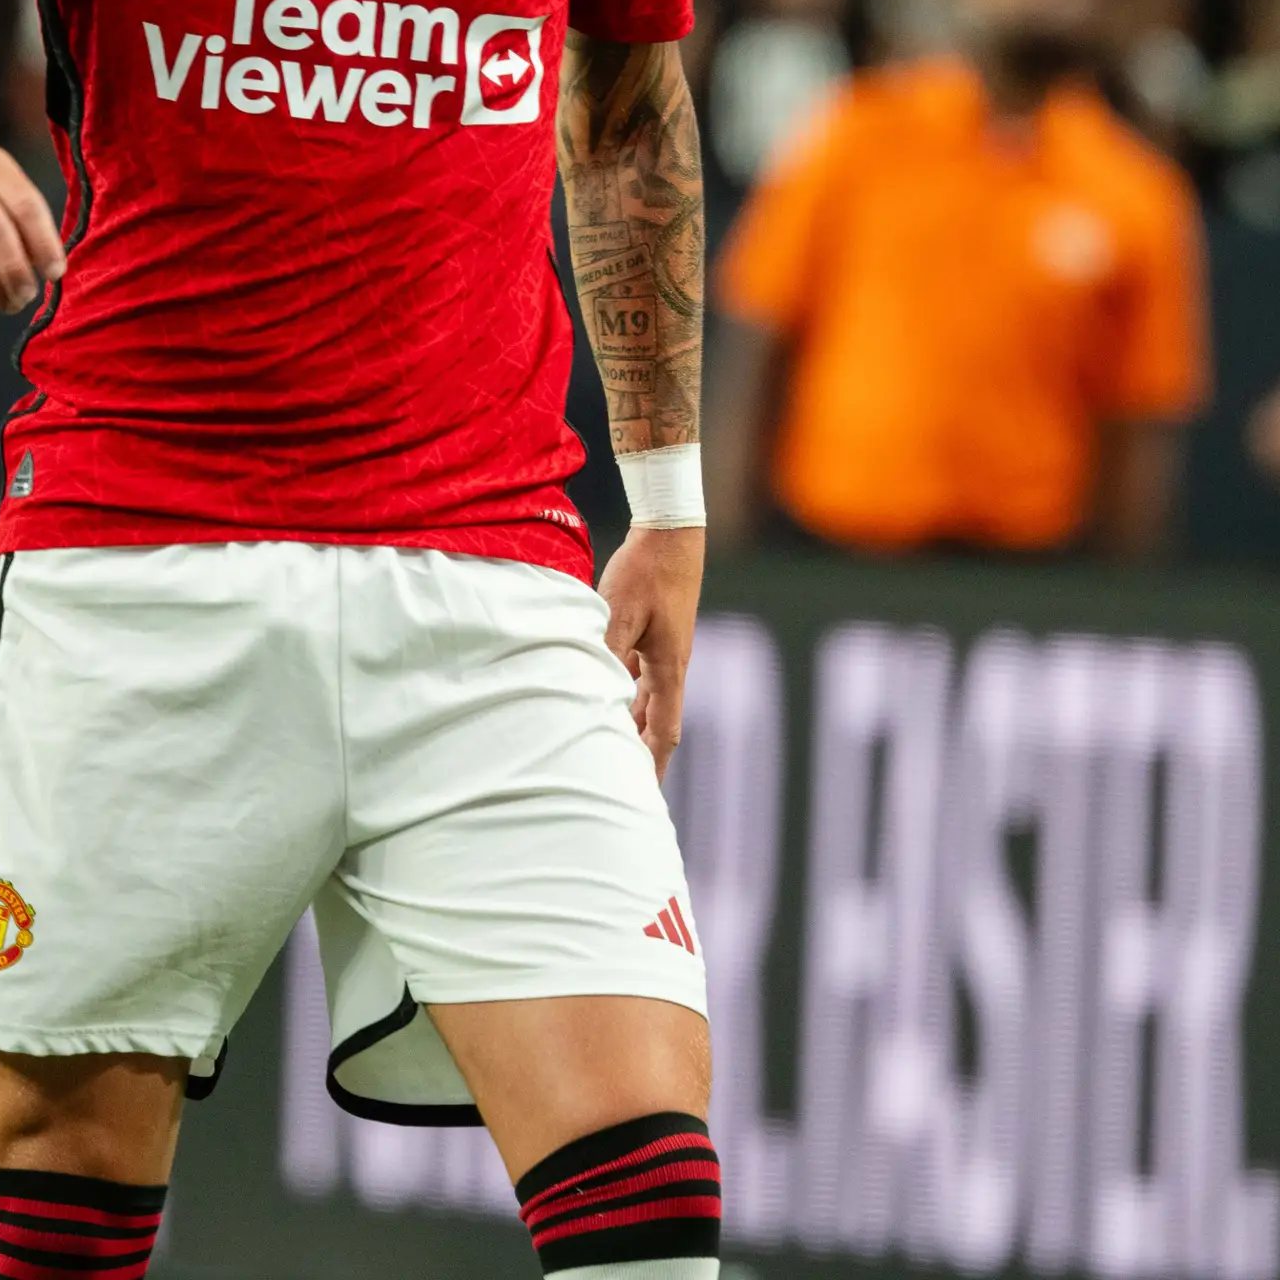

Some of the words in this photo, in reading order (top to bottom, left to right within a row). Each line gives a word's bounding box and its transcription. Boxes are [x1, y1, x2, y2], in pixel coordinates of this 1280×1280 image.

[142, 21, 457, 129] Viewer
[598, 310, 650, 337] M9
[603, 367, 651, 383] NORTH
